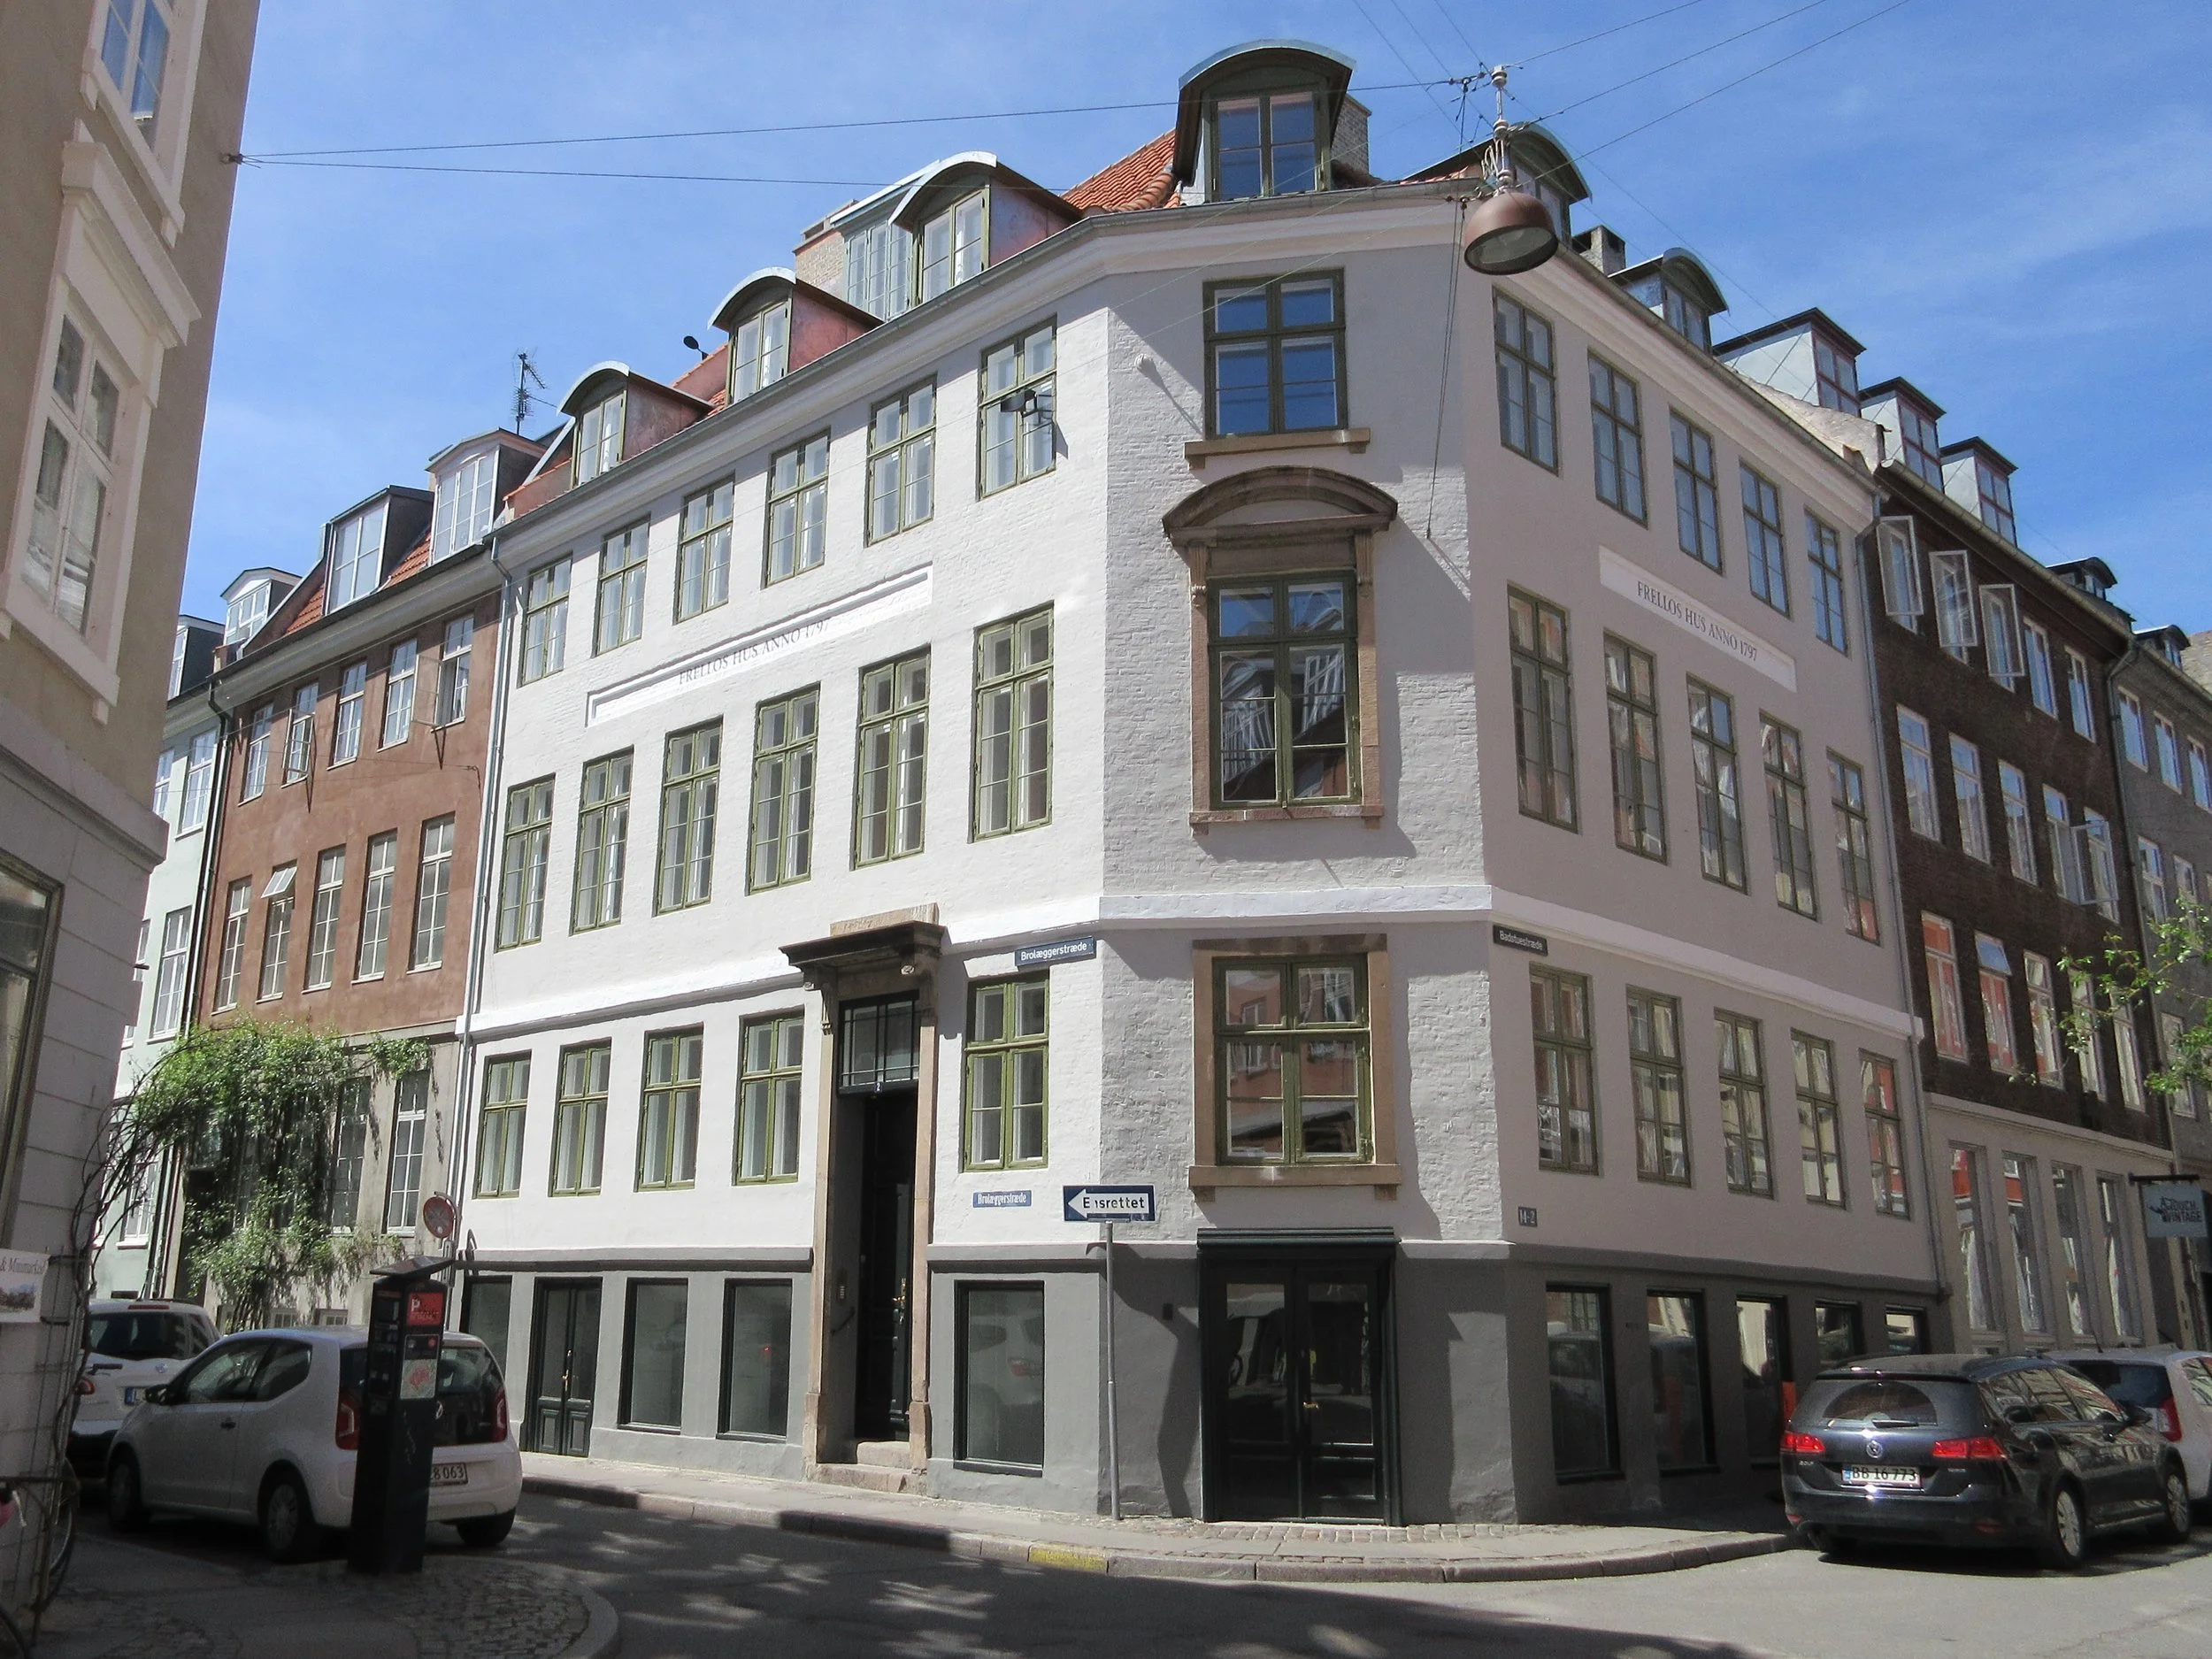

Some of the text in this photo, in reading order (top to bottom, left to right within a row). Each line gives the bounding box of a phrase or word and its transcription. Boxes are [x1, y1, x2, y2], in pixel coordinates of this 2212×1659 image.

[1637, 580, 1758, 662] FRELLOS HUS ANNO 1797
[679, 618, 831, 685] FRELLOS HUS ANNO 1797
[1020, 941, 1087, 961] Brolæggerstræde
[977, 1192, 1027, 1206] Brolæggerstræde
[442, 1465, 465, 1479] 063
[1874, 1467, 1889, 1480] 16
[1892, 1468, 1916, 1481] 773
